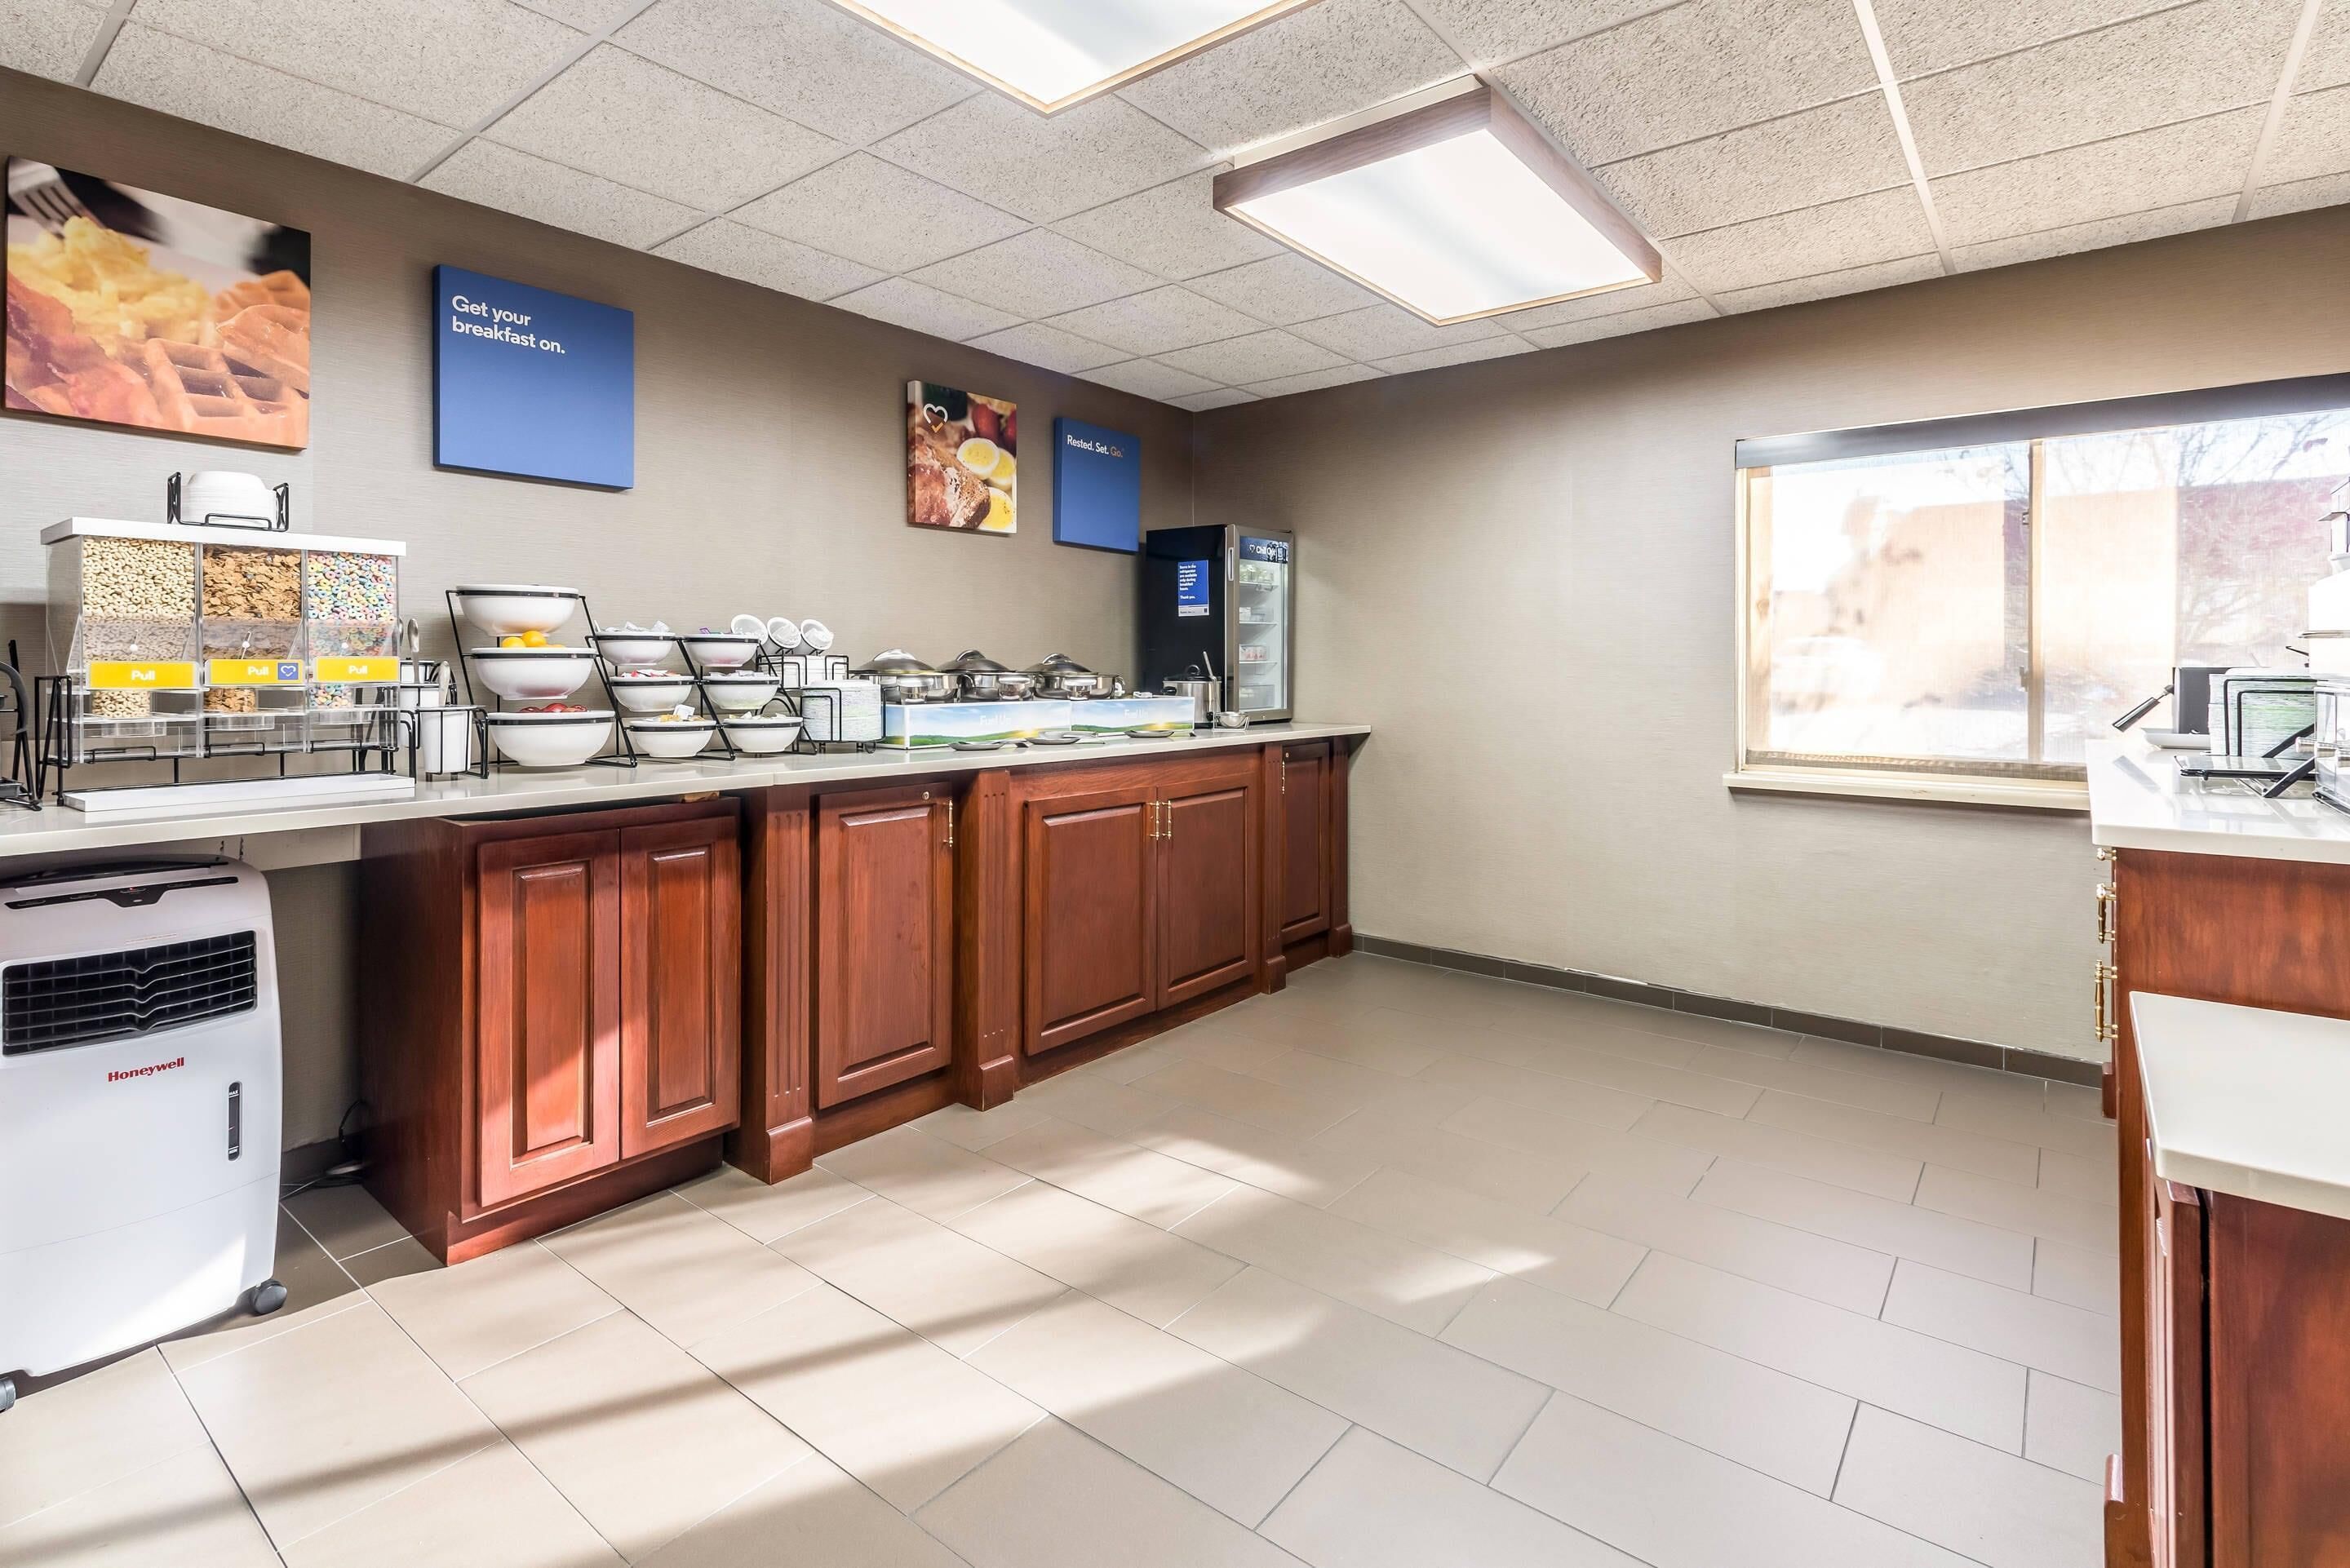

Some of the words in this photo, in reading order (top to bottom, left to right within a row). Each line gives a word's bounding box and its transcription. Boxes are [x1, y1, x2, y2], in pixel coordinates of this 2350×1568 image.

[452, 295, 488, 317] Get
[491, 308, 531, 326] your
[452, 315, 536, 348] breakfast
[539, 339, 565, 354] on.
[1066, 434, 1094, 451] Rested.
[1095, 442, 1110, 455] Set.
[1111, 445, 1123, 458] Go.
[131, 670, 155, 680] Pull
[247, 666, 268, 675] Pull
[348, 665, 368, 675] Pull
[108, 1056, 184, 1083] Honeywell
